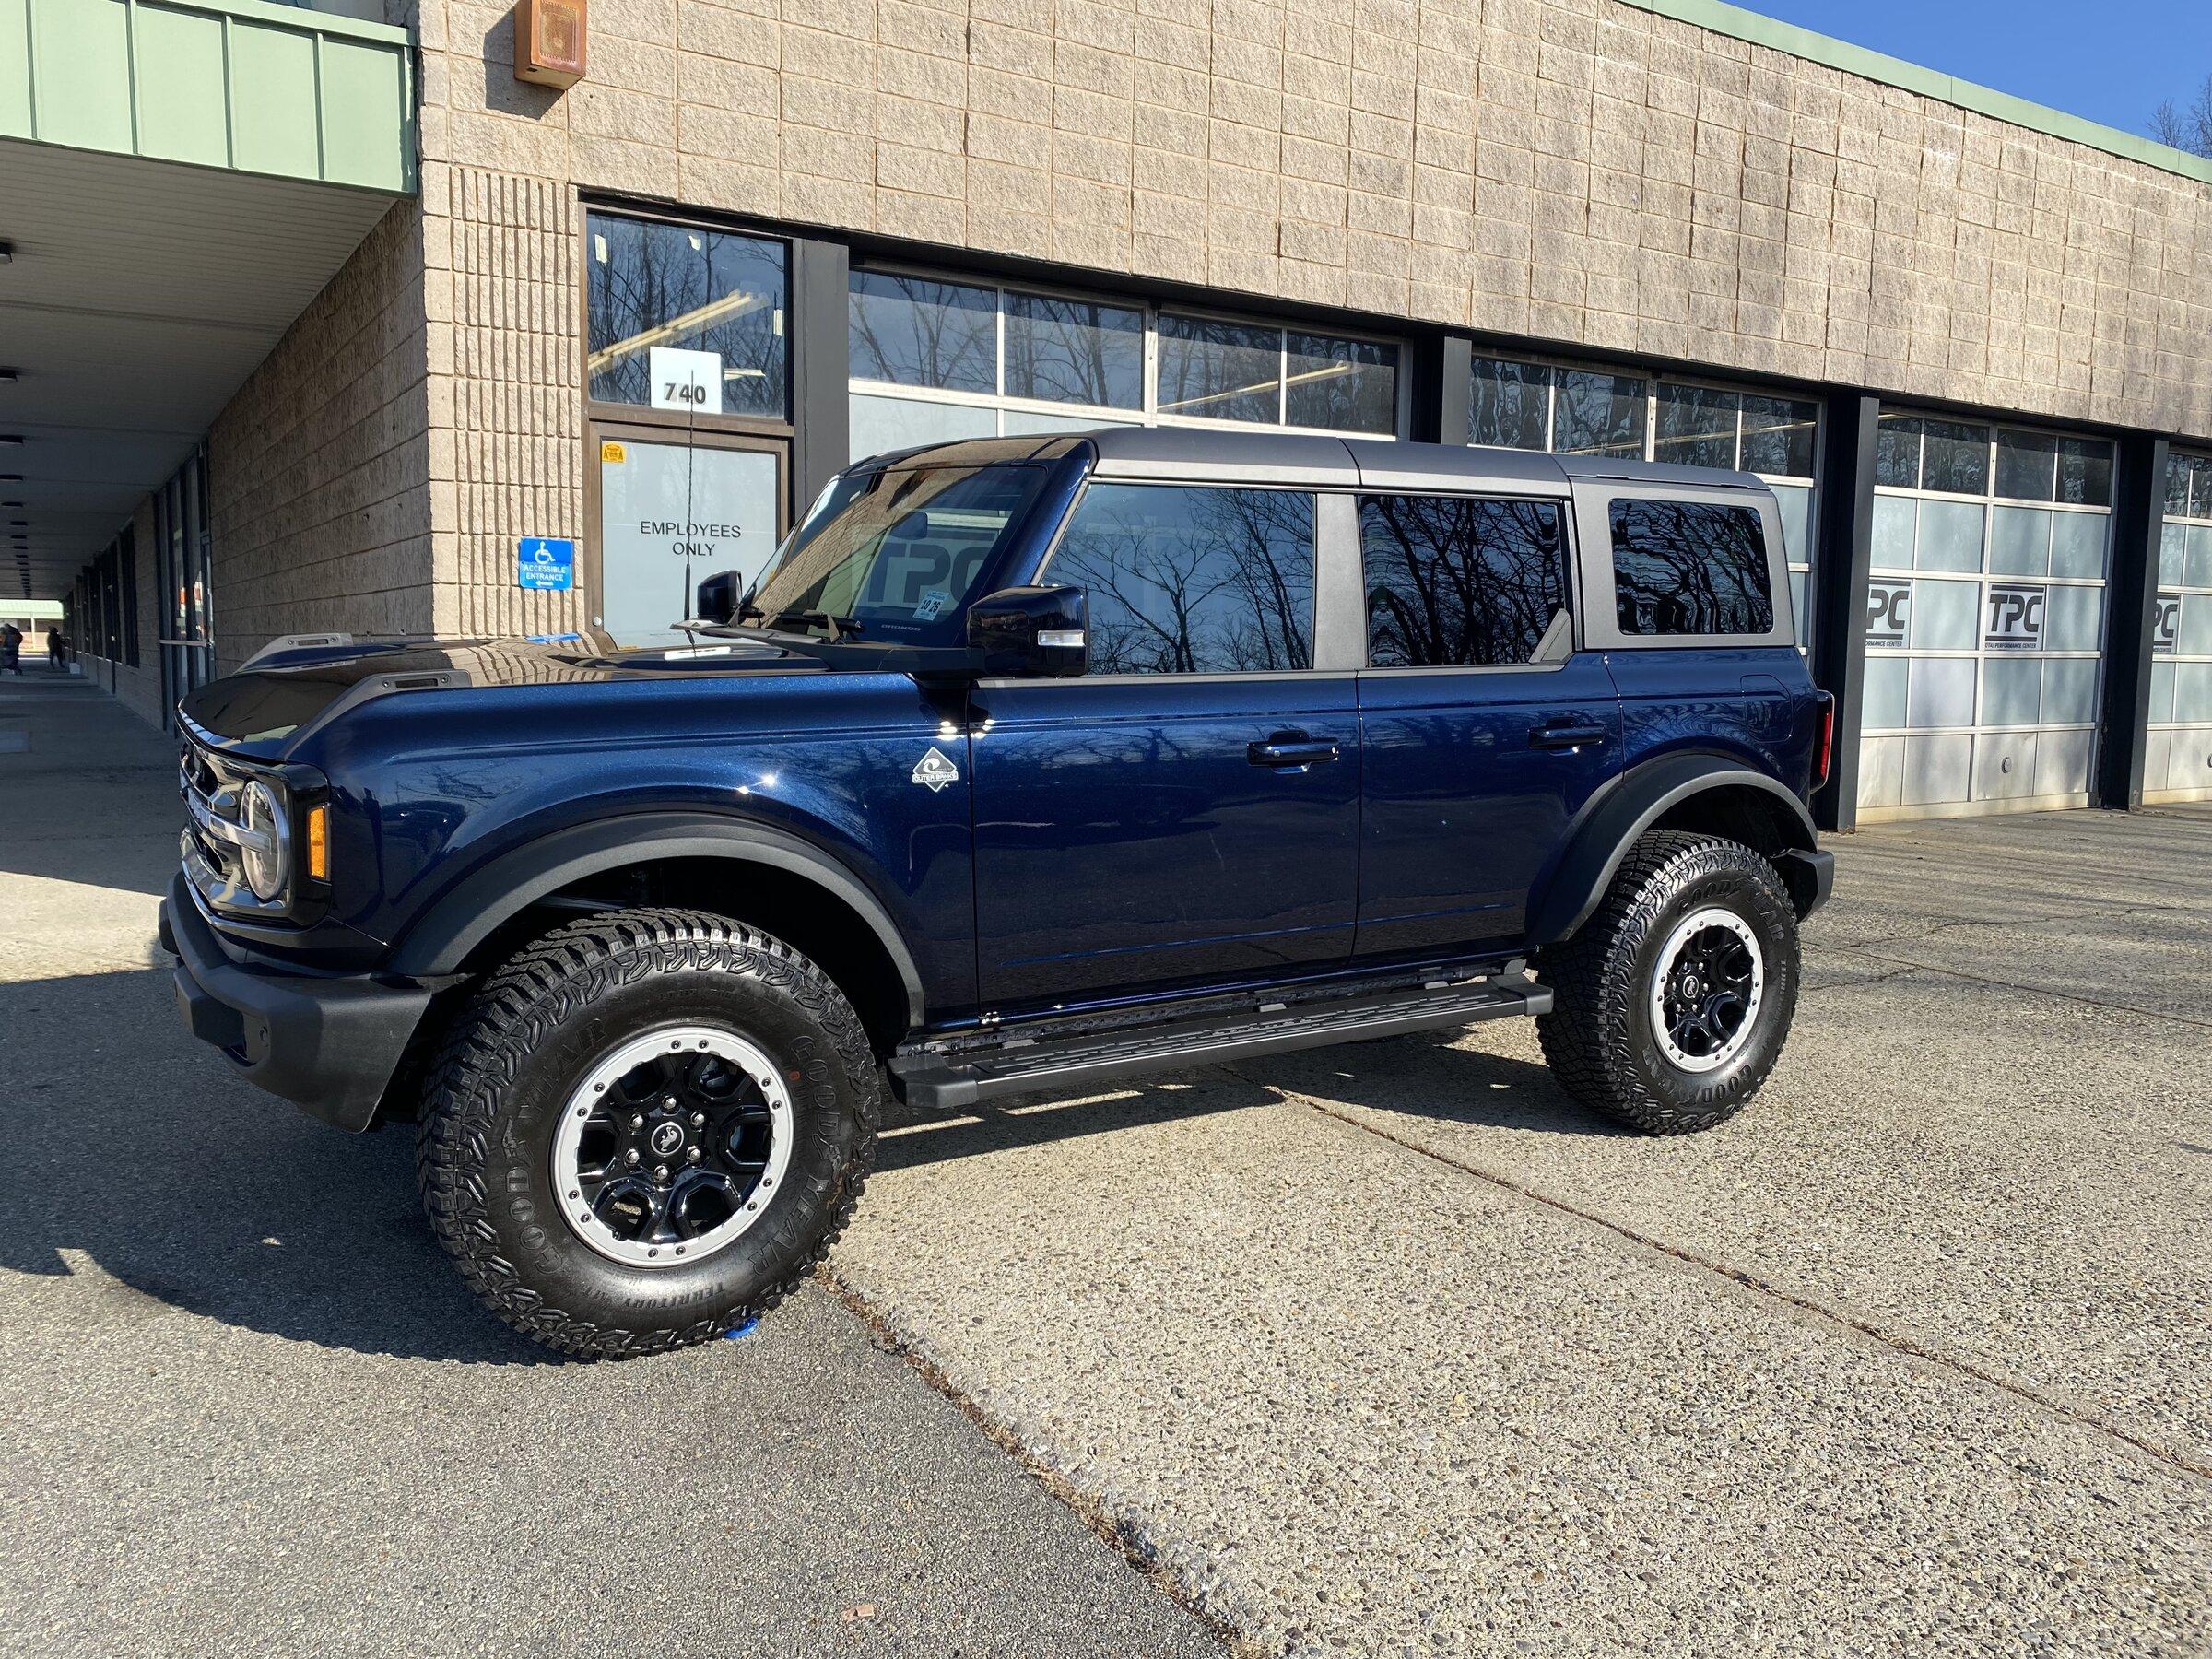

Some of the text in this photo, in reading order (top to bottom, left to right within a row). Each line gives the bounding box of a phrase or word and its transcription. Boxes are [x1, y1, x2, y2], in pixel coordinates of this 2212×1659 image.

[665, 382, 707, 404] 740
[640, 521, 741, 538] EMPLOYEES
[672, 542, 715, 556] ONLY
[524, 564, 567, 573] ACCESSIBLE
[525, 572, 564, 582] ENTRANCE
[1866, 589, 1910, 629] PC
[1989, 594, 2043, 632] TPC
